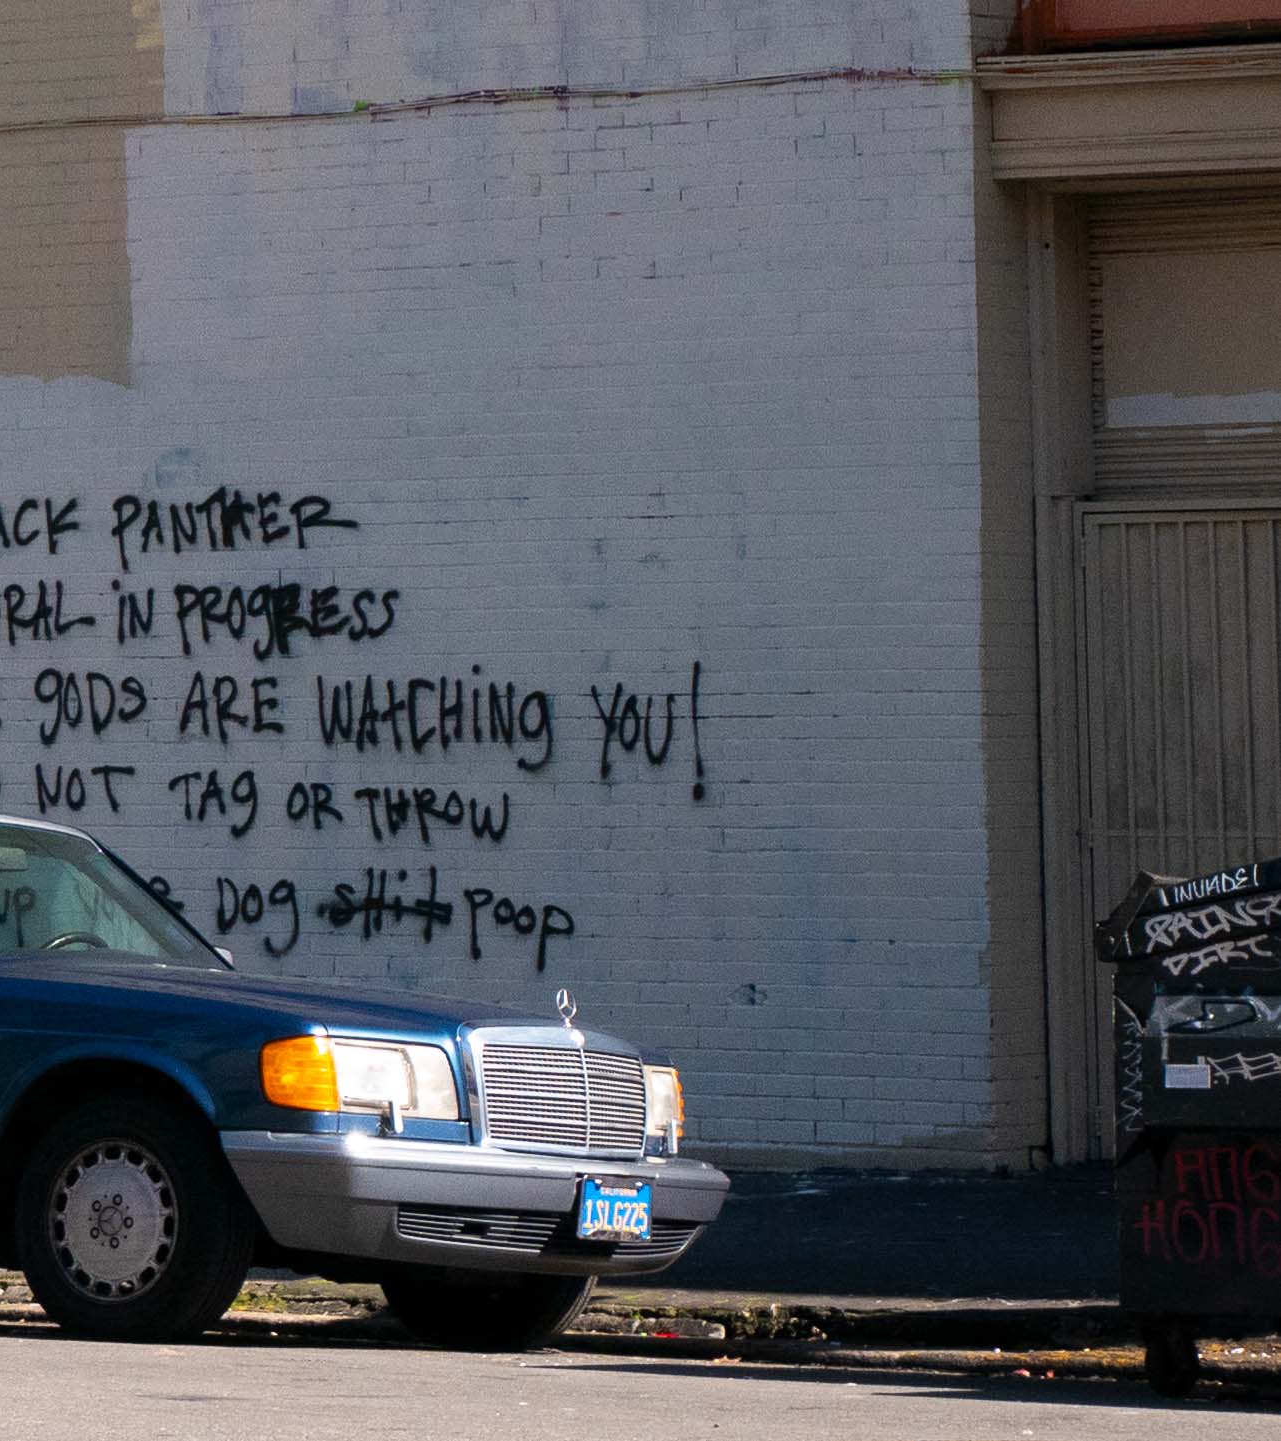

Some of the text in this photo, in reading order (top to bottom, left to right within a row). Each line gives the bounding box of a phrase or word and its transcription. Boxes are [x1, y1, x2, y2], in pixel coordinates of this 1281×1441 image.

[111, 486, 359, 571] PANTHER
[180, 670, 283, 745] ARE
[591, 660, 706, 801] YOU!
[35, 763, 135, 814] NOT
[286, 781, 344, 830] OR
[355, 786, 510, 845] THROW
[583, 1199, 648, 1233] 1SLG225
